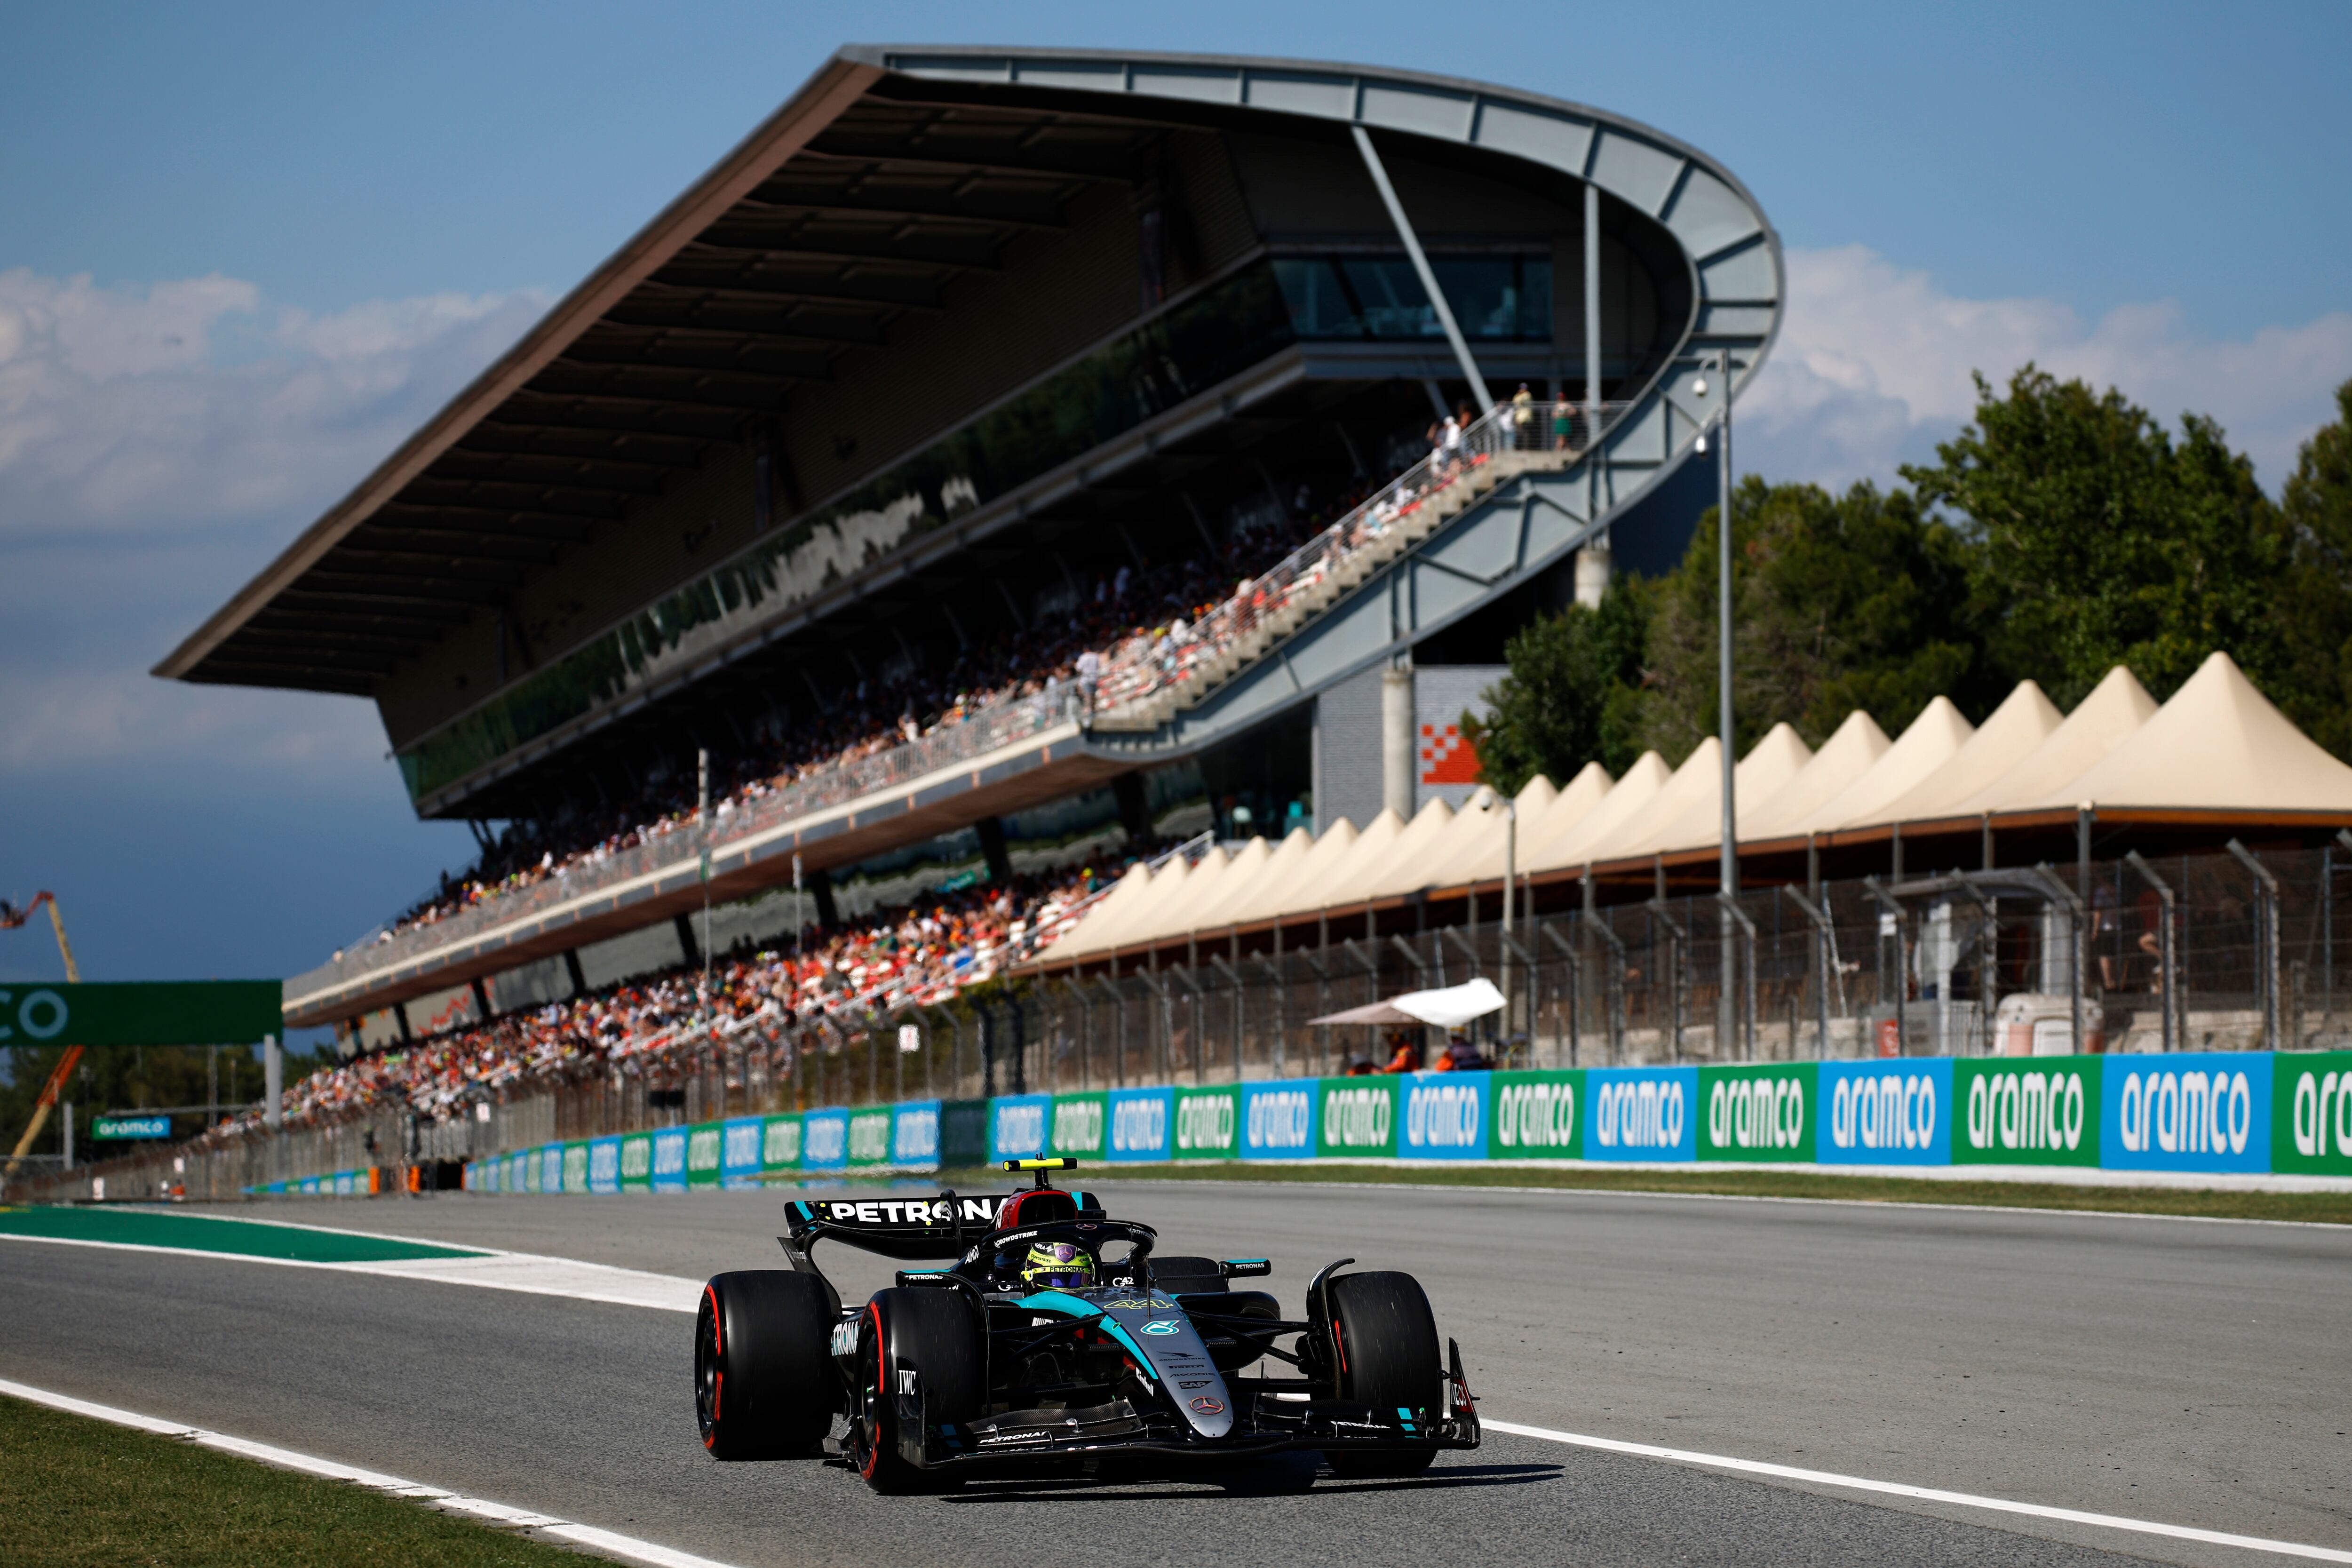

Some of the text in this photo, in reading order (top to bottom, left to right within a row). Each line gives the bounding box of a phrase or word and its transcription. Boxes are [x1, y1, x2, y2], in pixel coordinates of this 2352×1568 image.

[99, 1122, 164, 1135] aramco
[1324, 1088, 1391, 1147] aramco
[1407, 1085, 1478, 1147] aramco
[1498, 1083, 1574, 1147] aramco
[1597, 1081, 1684, 1148] aramco
[1709, 1078, 1804, 1148] aramco
[1832, 1075, 1936, 1149] aramco
[1968, 1072, 2084, 1151] aramco
[2120, 1071, 2251, 1154] aramco
[996, 1231, 1038, 1246] CROWDSTRIKE
[1104, 1299, 1174, 1309] 44
[1112, 1277, 1134, 1289] G42
[898, 1370, 916, 1395] IWC
[1136, 1366, 1153, 1397] Einhell
